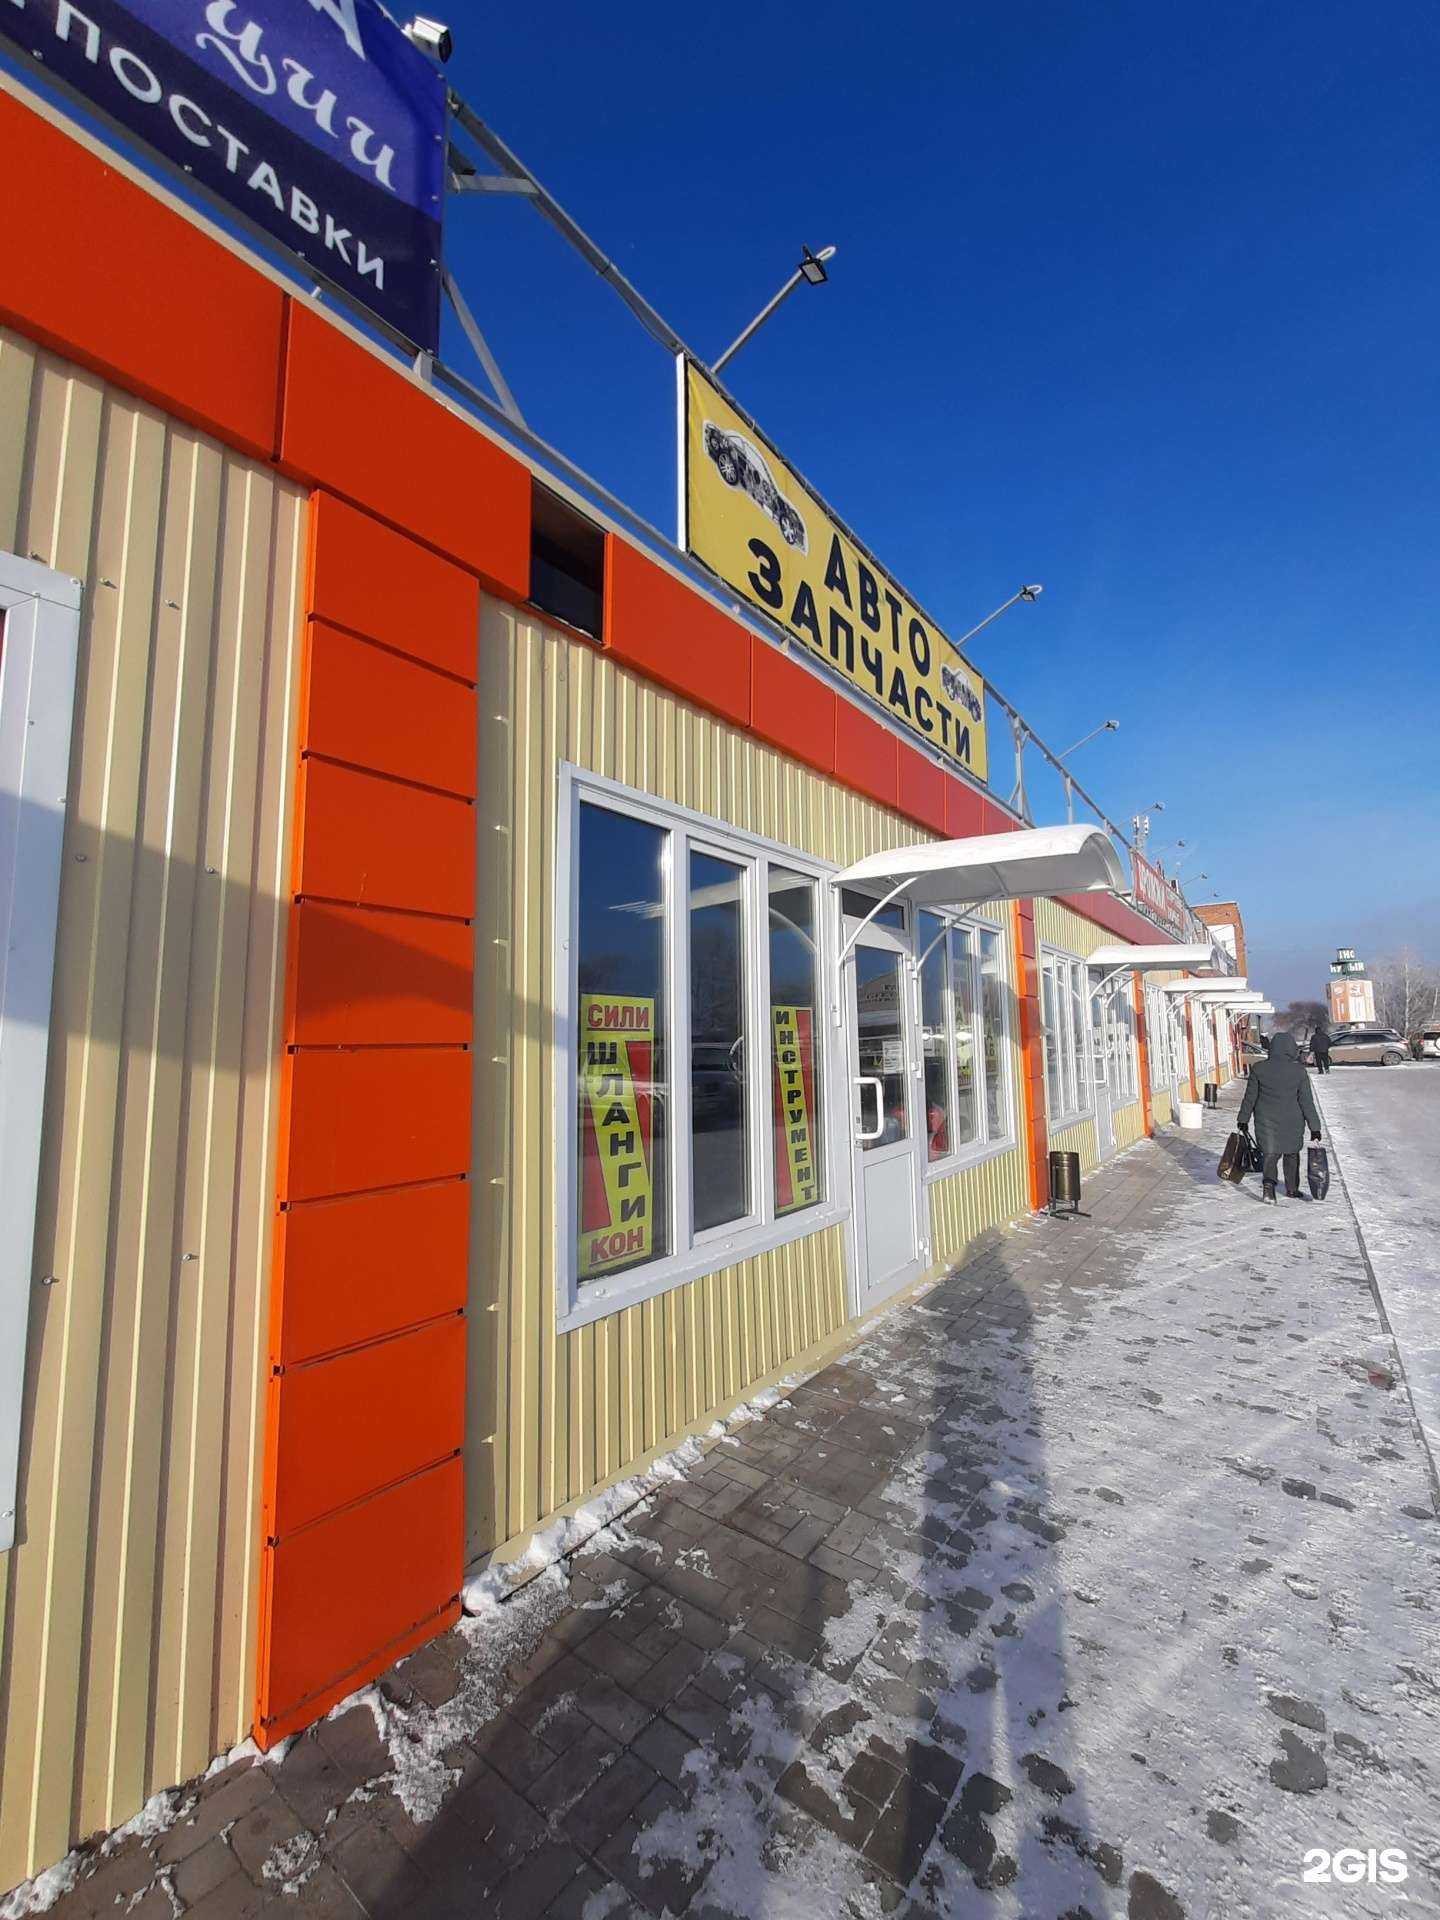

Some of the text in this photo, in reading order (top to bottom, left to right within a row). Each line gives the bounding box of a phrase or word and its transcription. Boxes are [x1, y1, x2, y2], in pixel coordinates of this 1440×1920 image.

[56, 0, 384, 290] ПОСТАВКИ
[747, 537, 971, 765] ЗАПЧАСТИ
[823, 533, 931, 678] АВТО
[588, 1004, 650, 1028] СИЛИ
[775, 1010, 815, 1201] ИНСТРУМЕНТ
[587, 1042, 646, 1223] ШЛАНГИ
[591, 1226, 645, 1258] КОН
